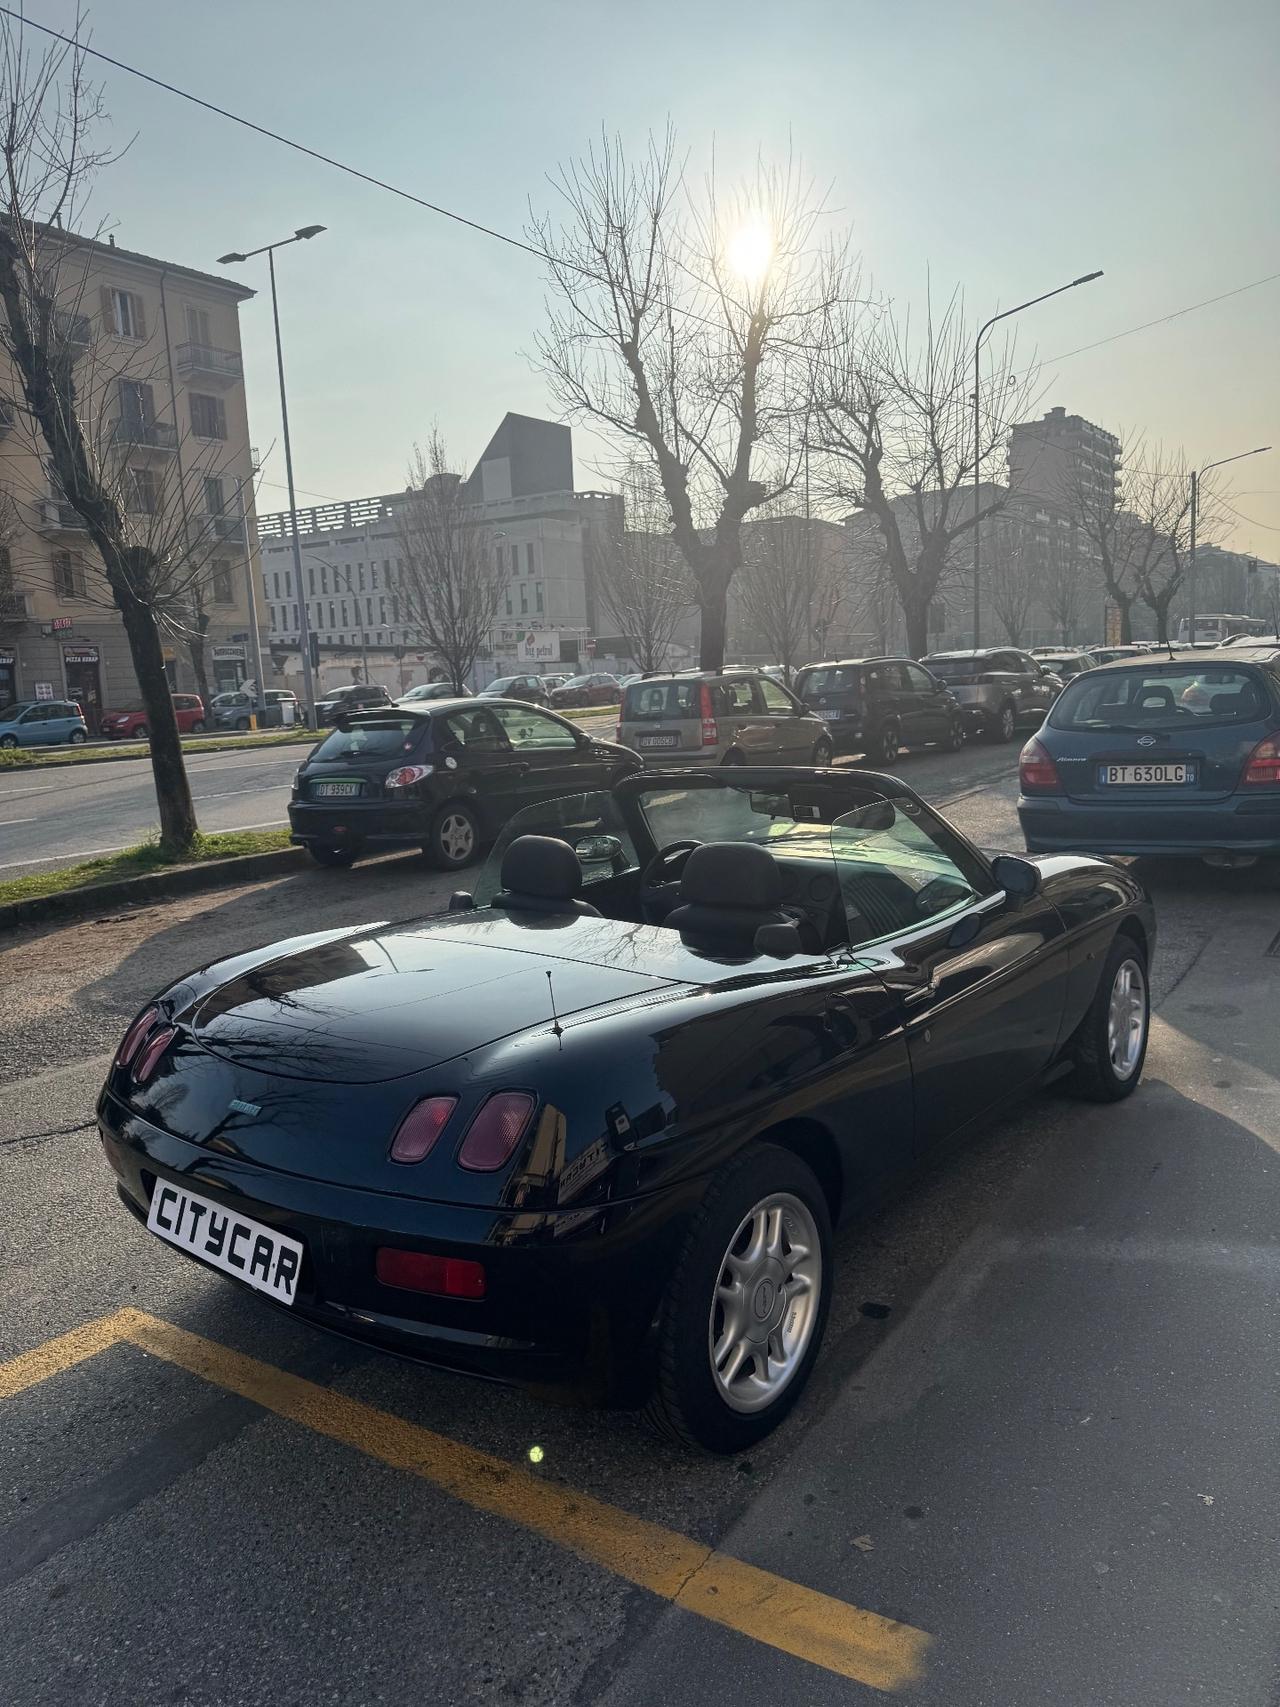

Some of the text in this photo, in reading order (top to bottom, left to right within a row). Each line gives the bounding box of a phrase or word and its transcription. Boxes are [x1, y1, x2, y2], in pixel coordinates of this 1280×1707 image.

[1109, 767, 1128, 782] BT
[1134, 766, 1183, 781] 630LG
[156, 1187, 299, 1295] CITYCAR
